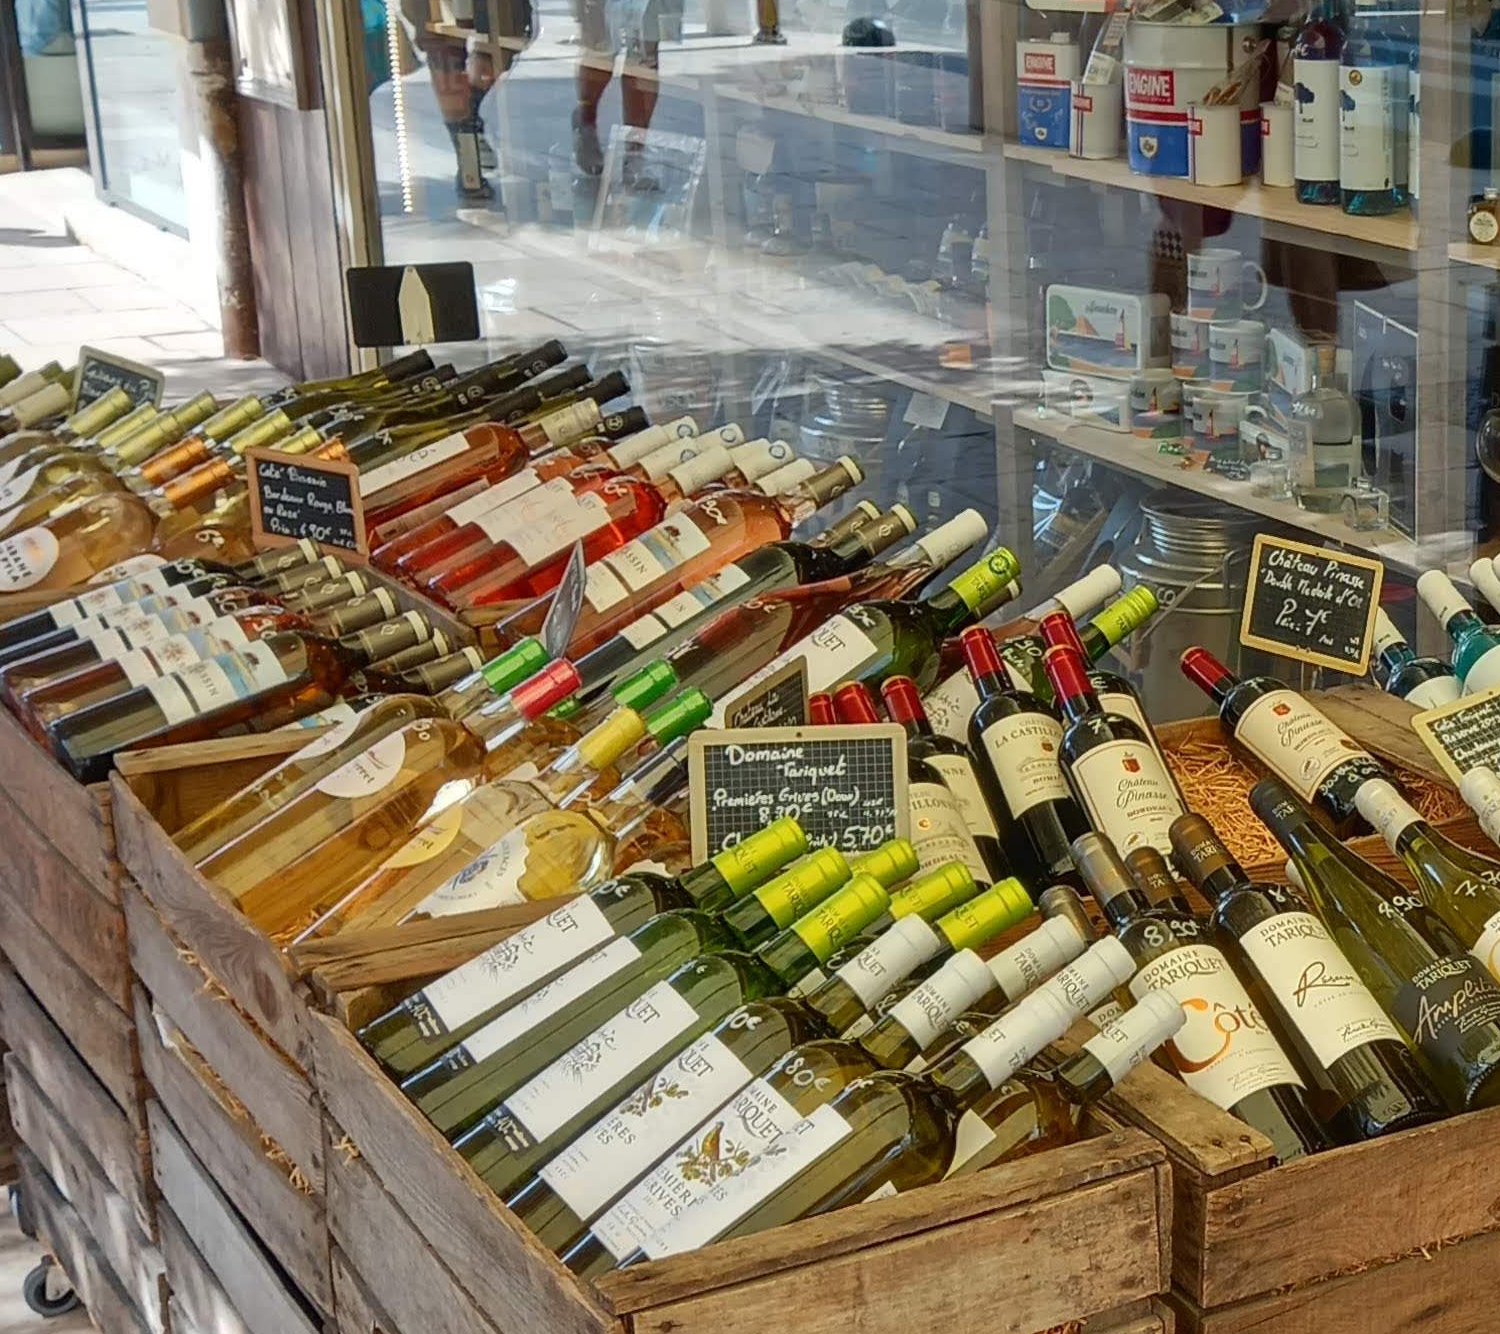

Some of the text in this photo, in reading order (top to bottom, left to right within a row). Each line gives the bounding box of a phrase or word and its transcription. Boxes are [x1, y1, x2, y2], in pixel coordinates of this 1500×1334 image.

[1128, 71, 1171, 97] ENGINE
[1267, 549, 1366, 590] Château Pinasse
[724, 743, 805, 767] Domaine
[776, 753, 848, 780] Tariquet
[1115, 787, 1169, 810] Pinasse
[1117, 776, 1160, 793] Château
[1142, 947, 1201, 983] DOMAINE
[1146, 954, 1227, 994] TARIQUET
[1411, 954, 1453, 984] DOMAINE
[1414, 959, 1474, 992] TARIQUET
